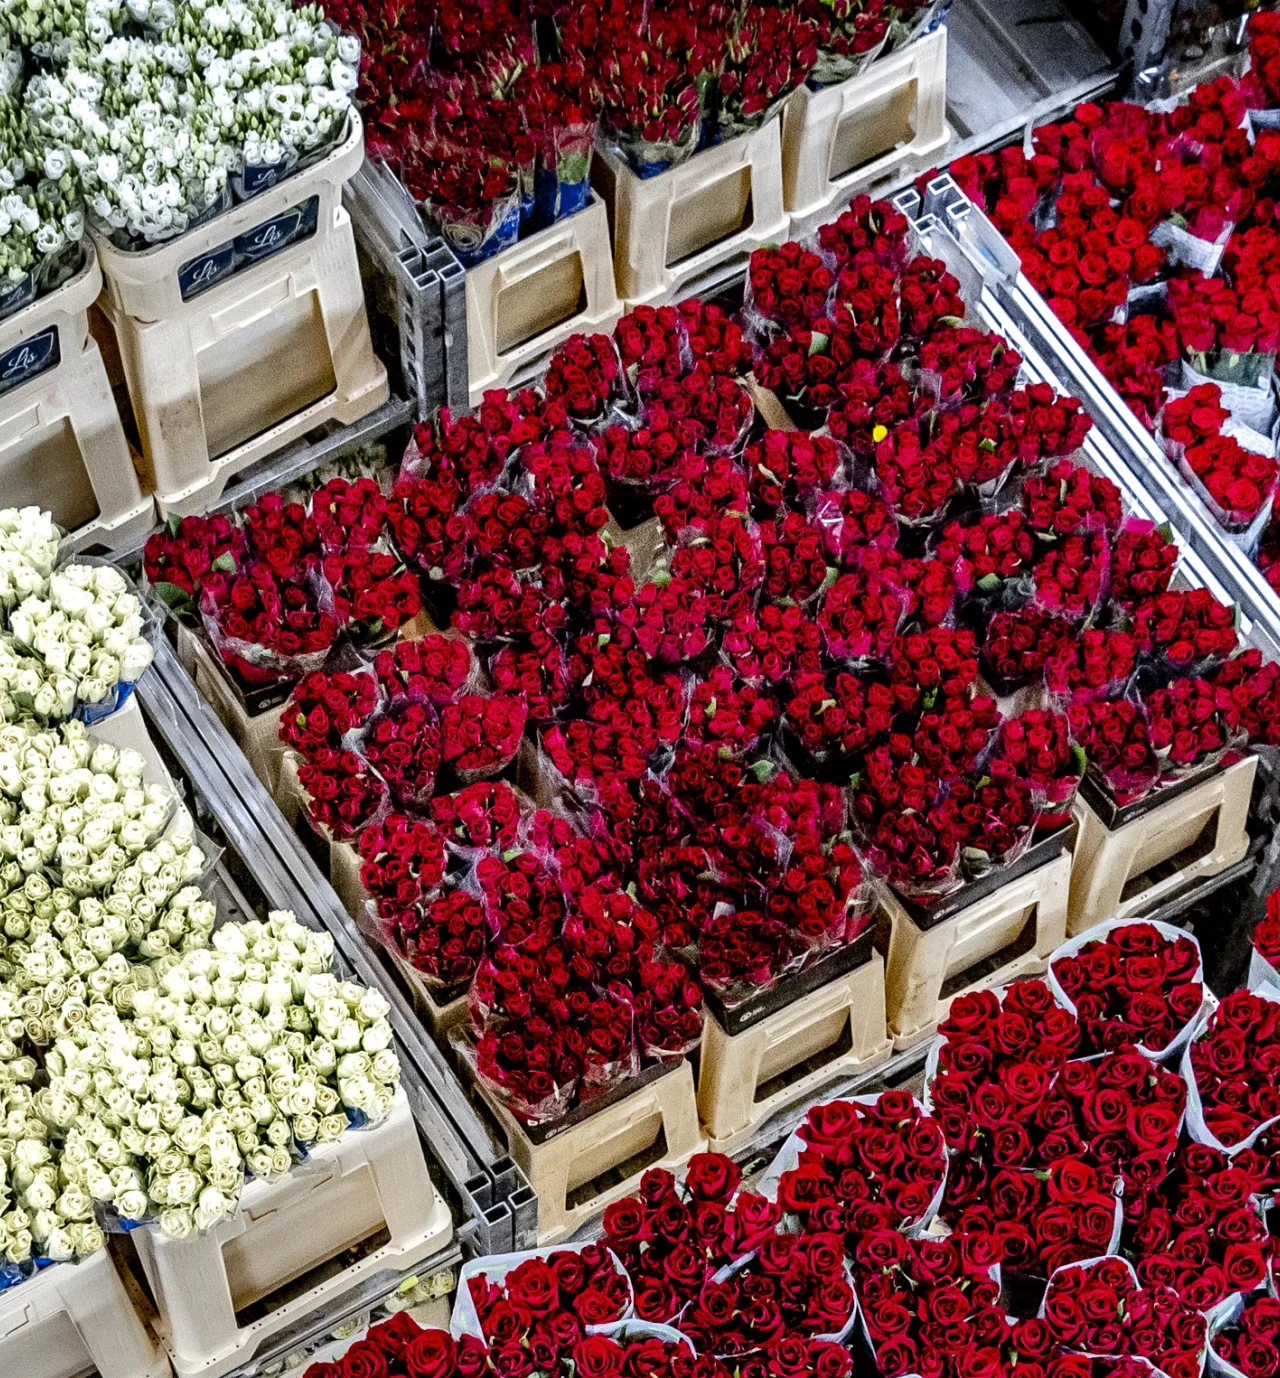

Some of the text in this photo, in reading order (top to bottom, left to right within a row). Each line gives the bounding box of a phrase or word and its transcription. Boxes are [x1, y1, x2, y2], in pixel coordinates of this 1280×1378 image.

[246, 225, 282, 251] Lis
[186, 259, 219, 292] Lis
[2, 346, 37, 378] Lis
